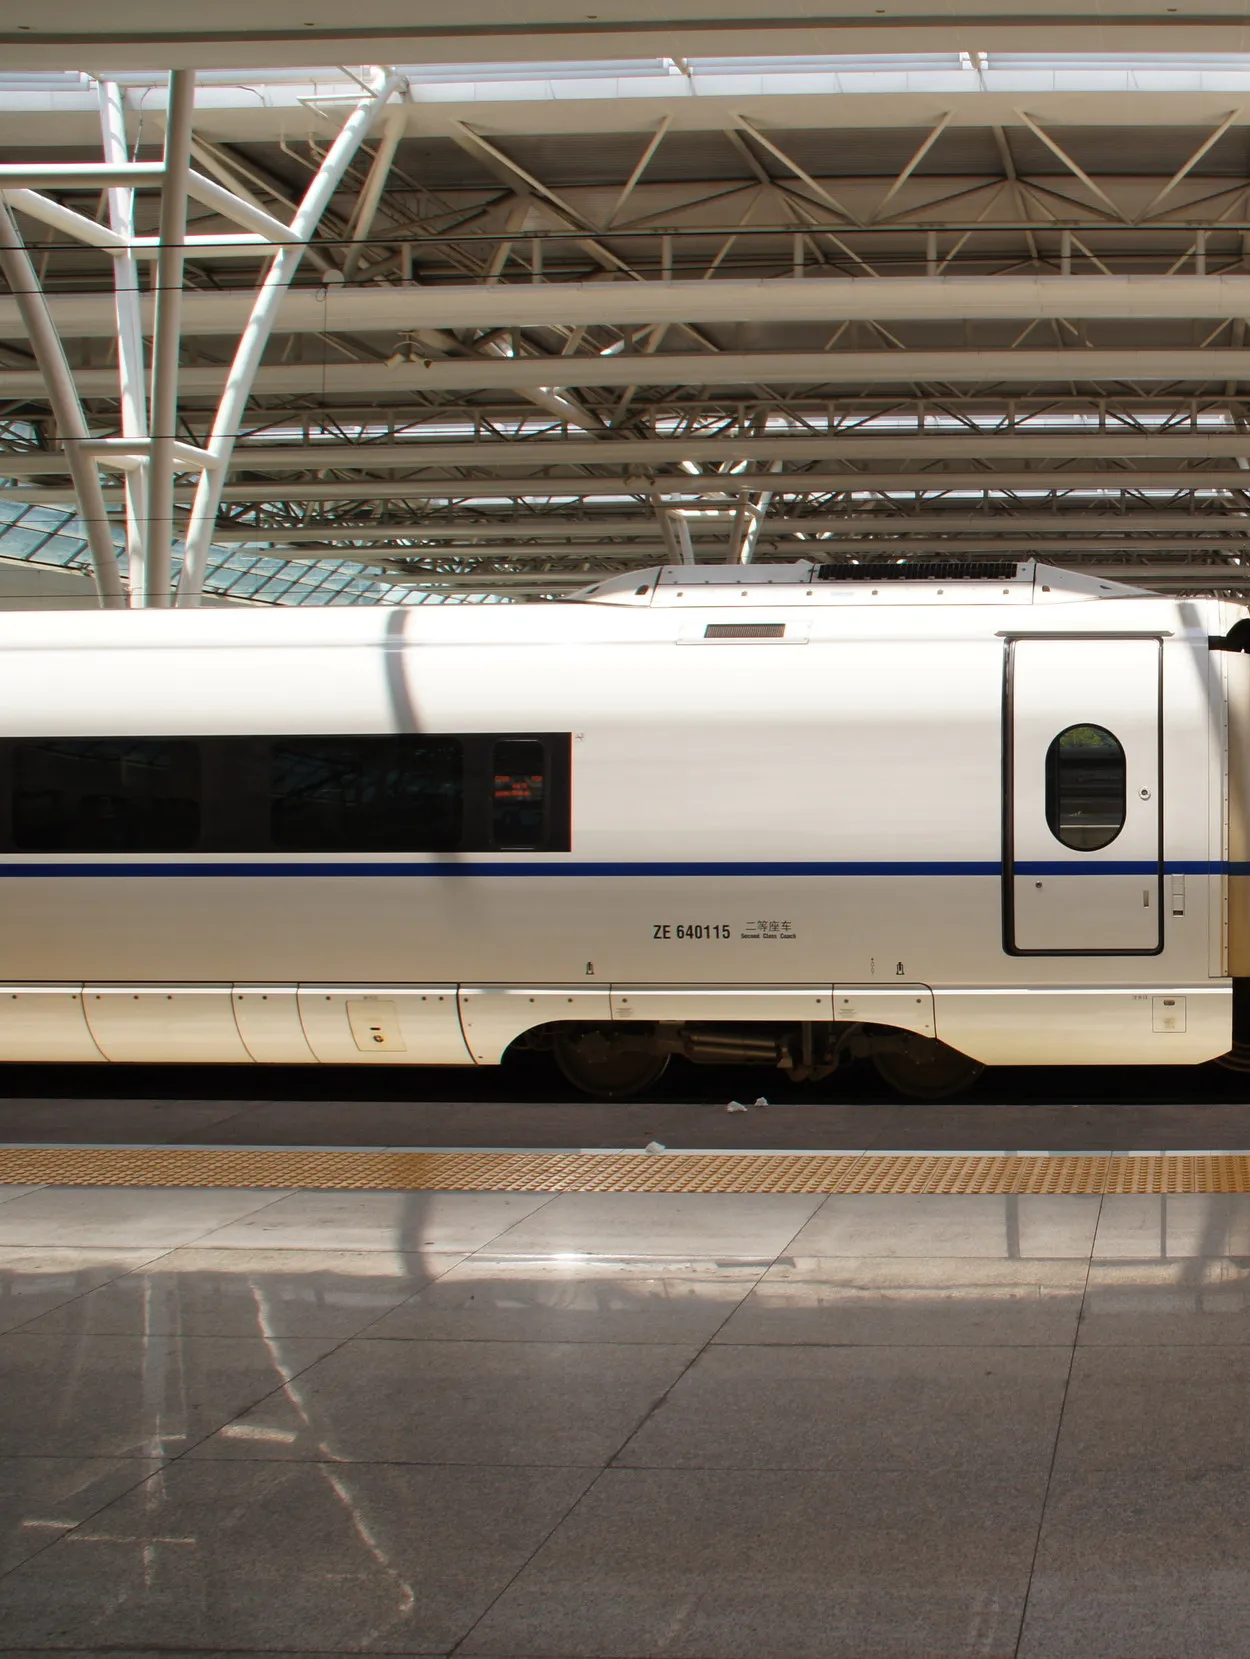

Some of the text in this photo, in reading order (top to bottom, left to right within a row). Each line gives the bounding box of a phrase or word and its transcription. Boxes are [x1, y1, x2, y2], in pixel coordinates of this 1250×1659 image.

[653, 924, 731, 939] ZE 640115
[745, 920, 792, 932] 二等座车
